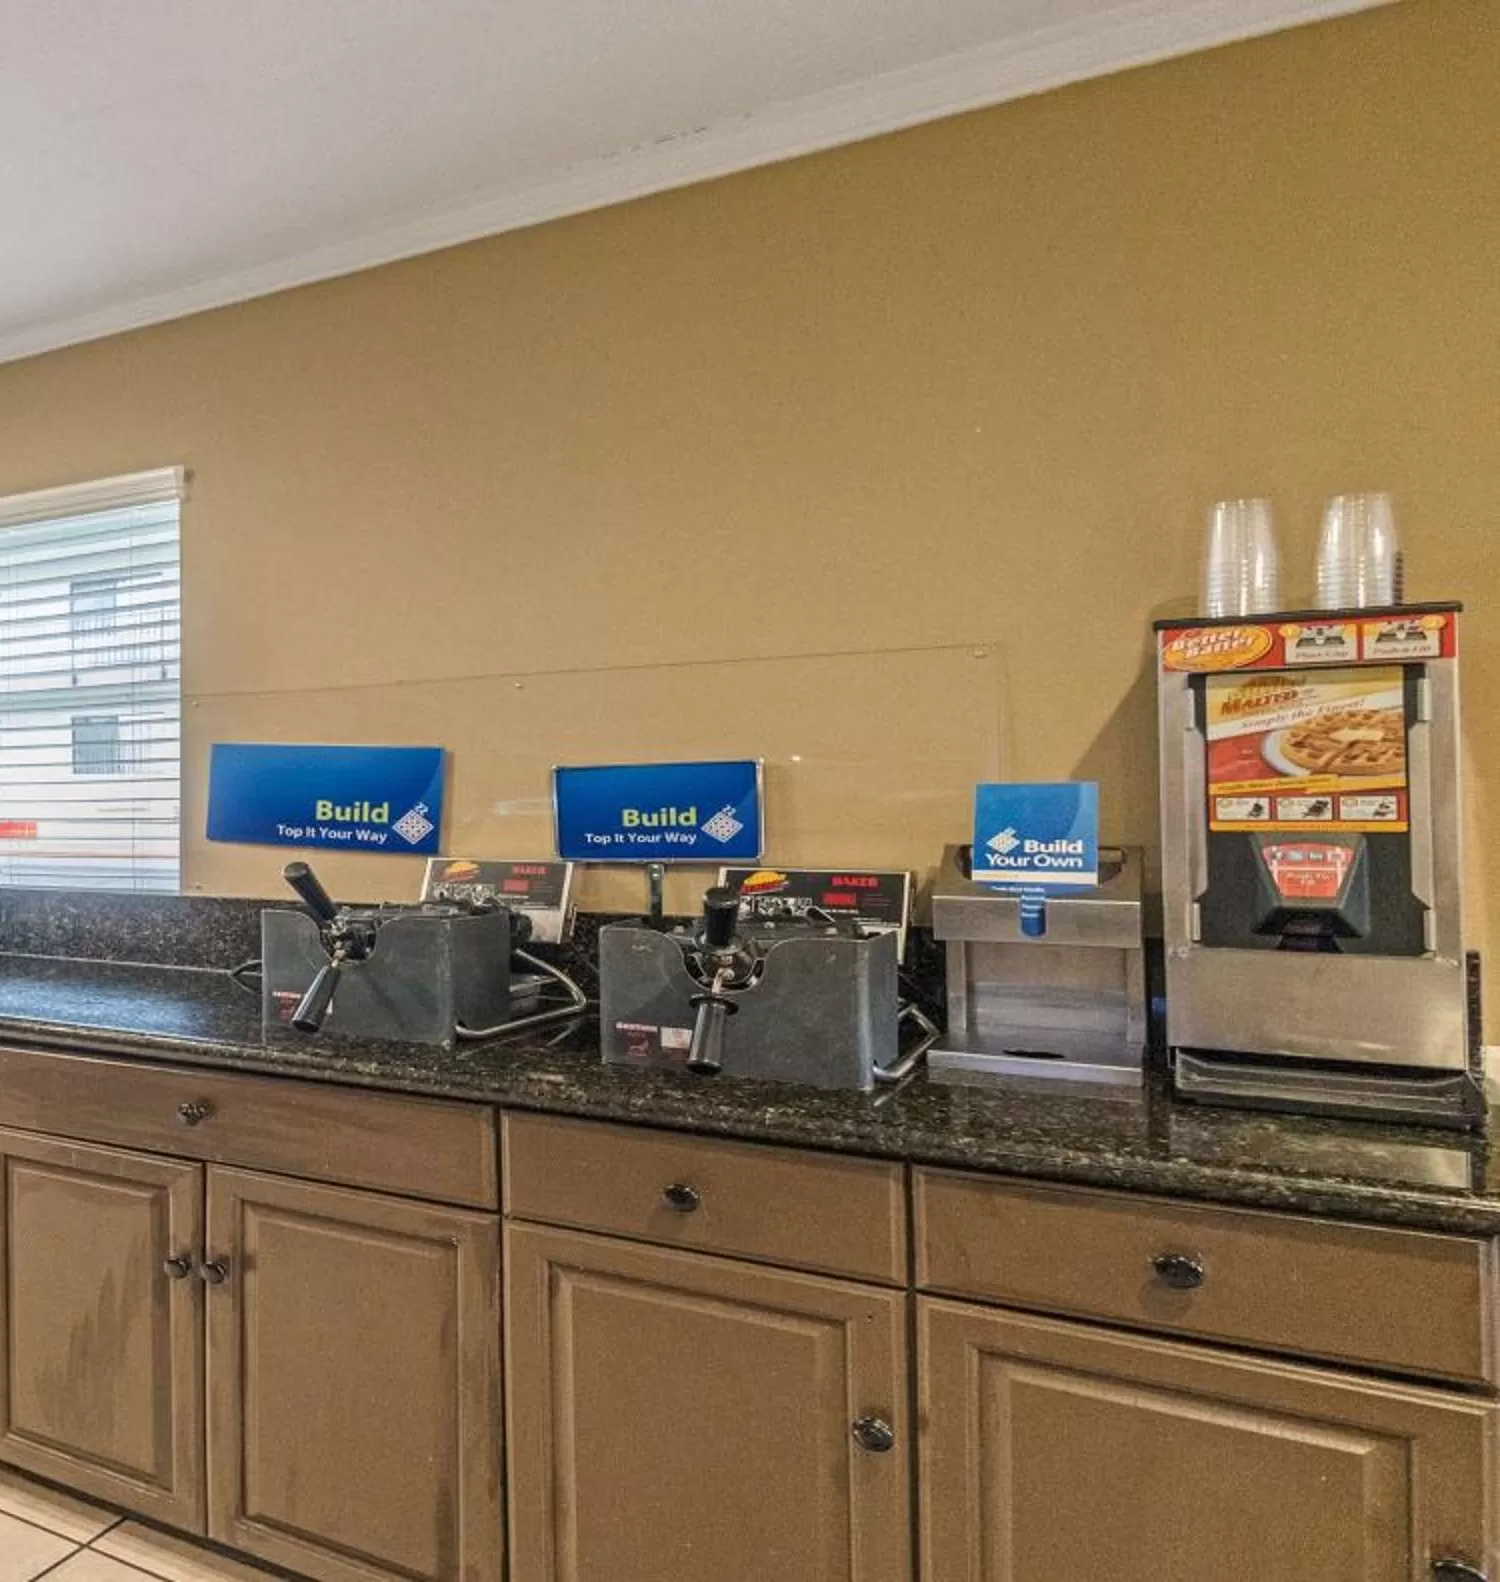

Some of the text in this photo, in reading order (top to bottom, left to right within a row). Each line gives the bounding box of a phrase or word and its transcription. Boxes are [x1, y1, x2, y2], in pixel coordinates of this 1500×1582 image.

[315, 799, 389, 823] Build
[621, 806, 697, 827] Build
[277, 824, 303, 839] Top
[319, 828, 352, 840] Your
[355, 830, 388, 844] Way
[584, 833, 611, 845] Top
[627, 833, 661, 843] Your
[664, 832, 697, 845] Way
[1023, 840, 1083, 854] Build
[985, 853, 1083, 868] Your Own
